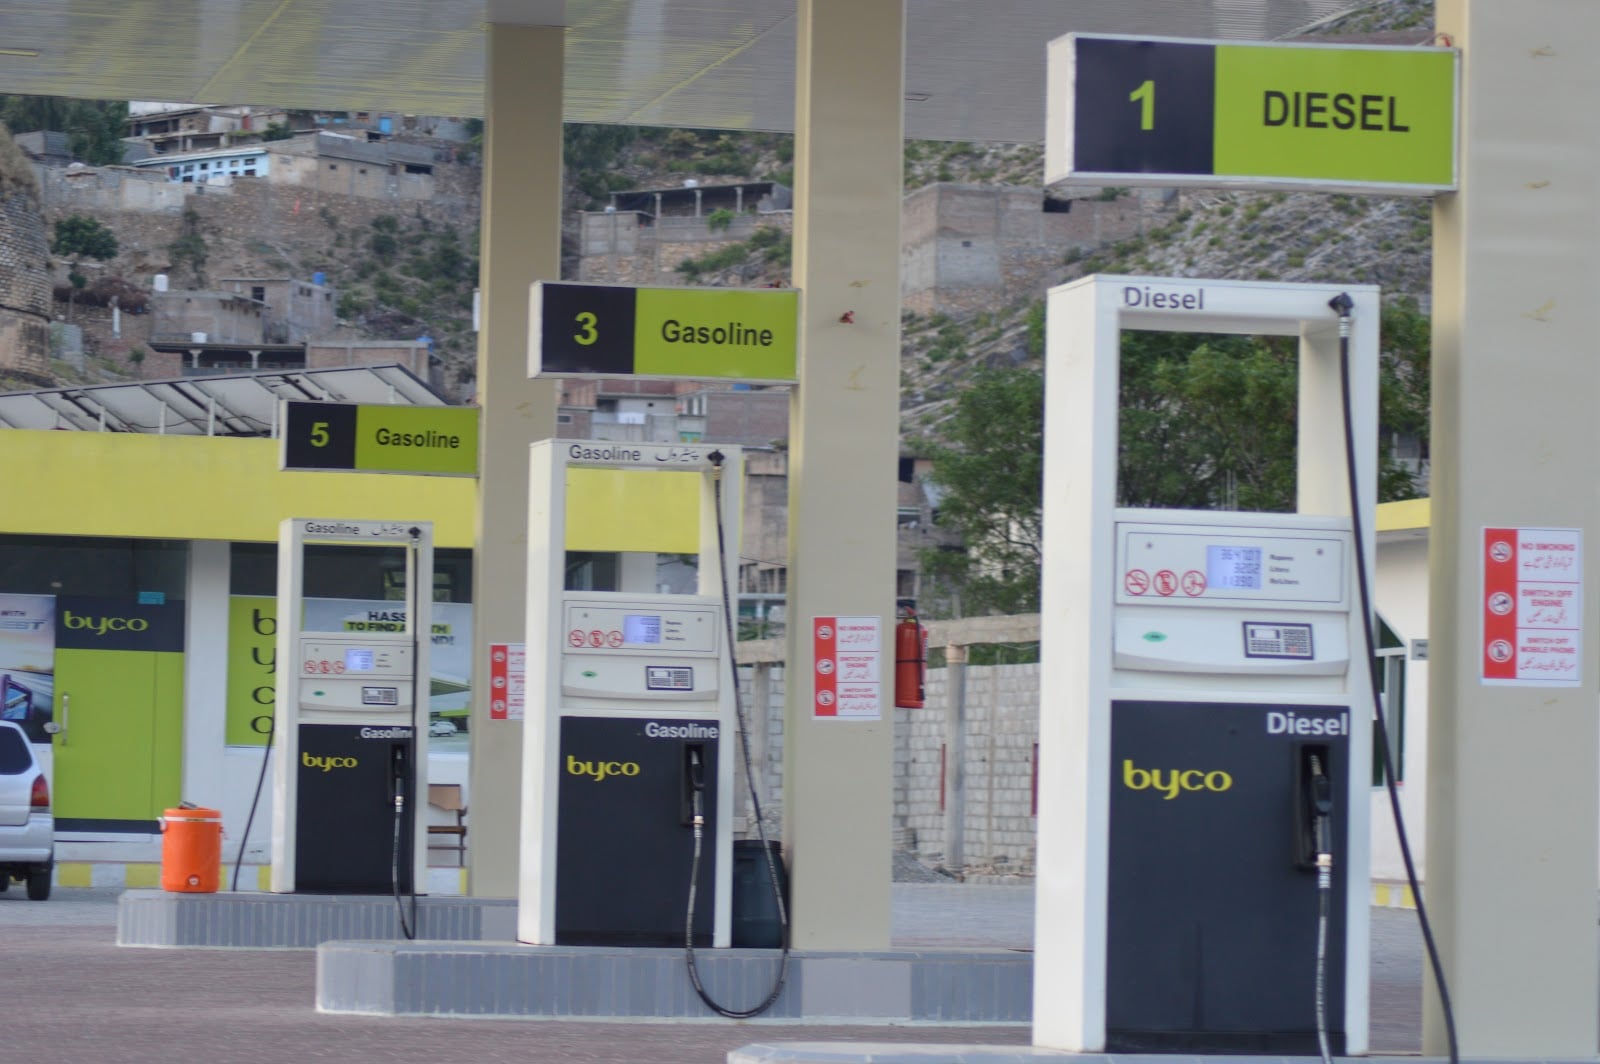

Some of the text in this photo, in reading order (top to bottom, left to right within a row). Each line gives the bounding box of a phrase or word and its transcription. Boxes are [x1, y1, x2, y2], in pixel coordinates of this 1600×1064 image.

[1129, 80, 1409, 133] 1 DIESEL
[1124, 286, 1204, 310] Diesel
[574, 312, 773, 347] 3 Gasoline
[310, 422, 460, 449] 5 Gasoline
[569, 444, 641, 461] Gasoline
[304, 522, 360, 535] Gasoline
[64, 610, 149, 636] byco
[645, 722, 719, 739] Gasoline
[1266, 712, 1347, 736] Diesel
[302, 752, 359, 773] byco
[567, 755, 641, 782] byco
[1123, 759, 1233, 800] byco
